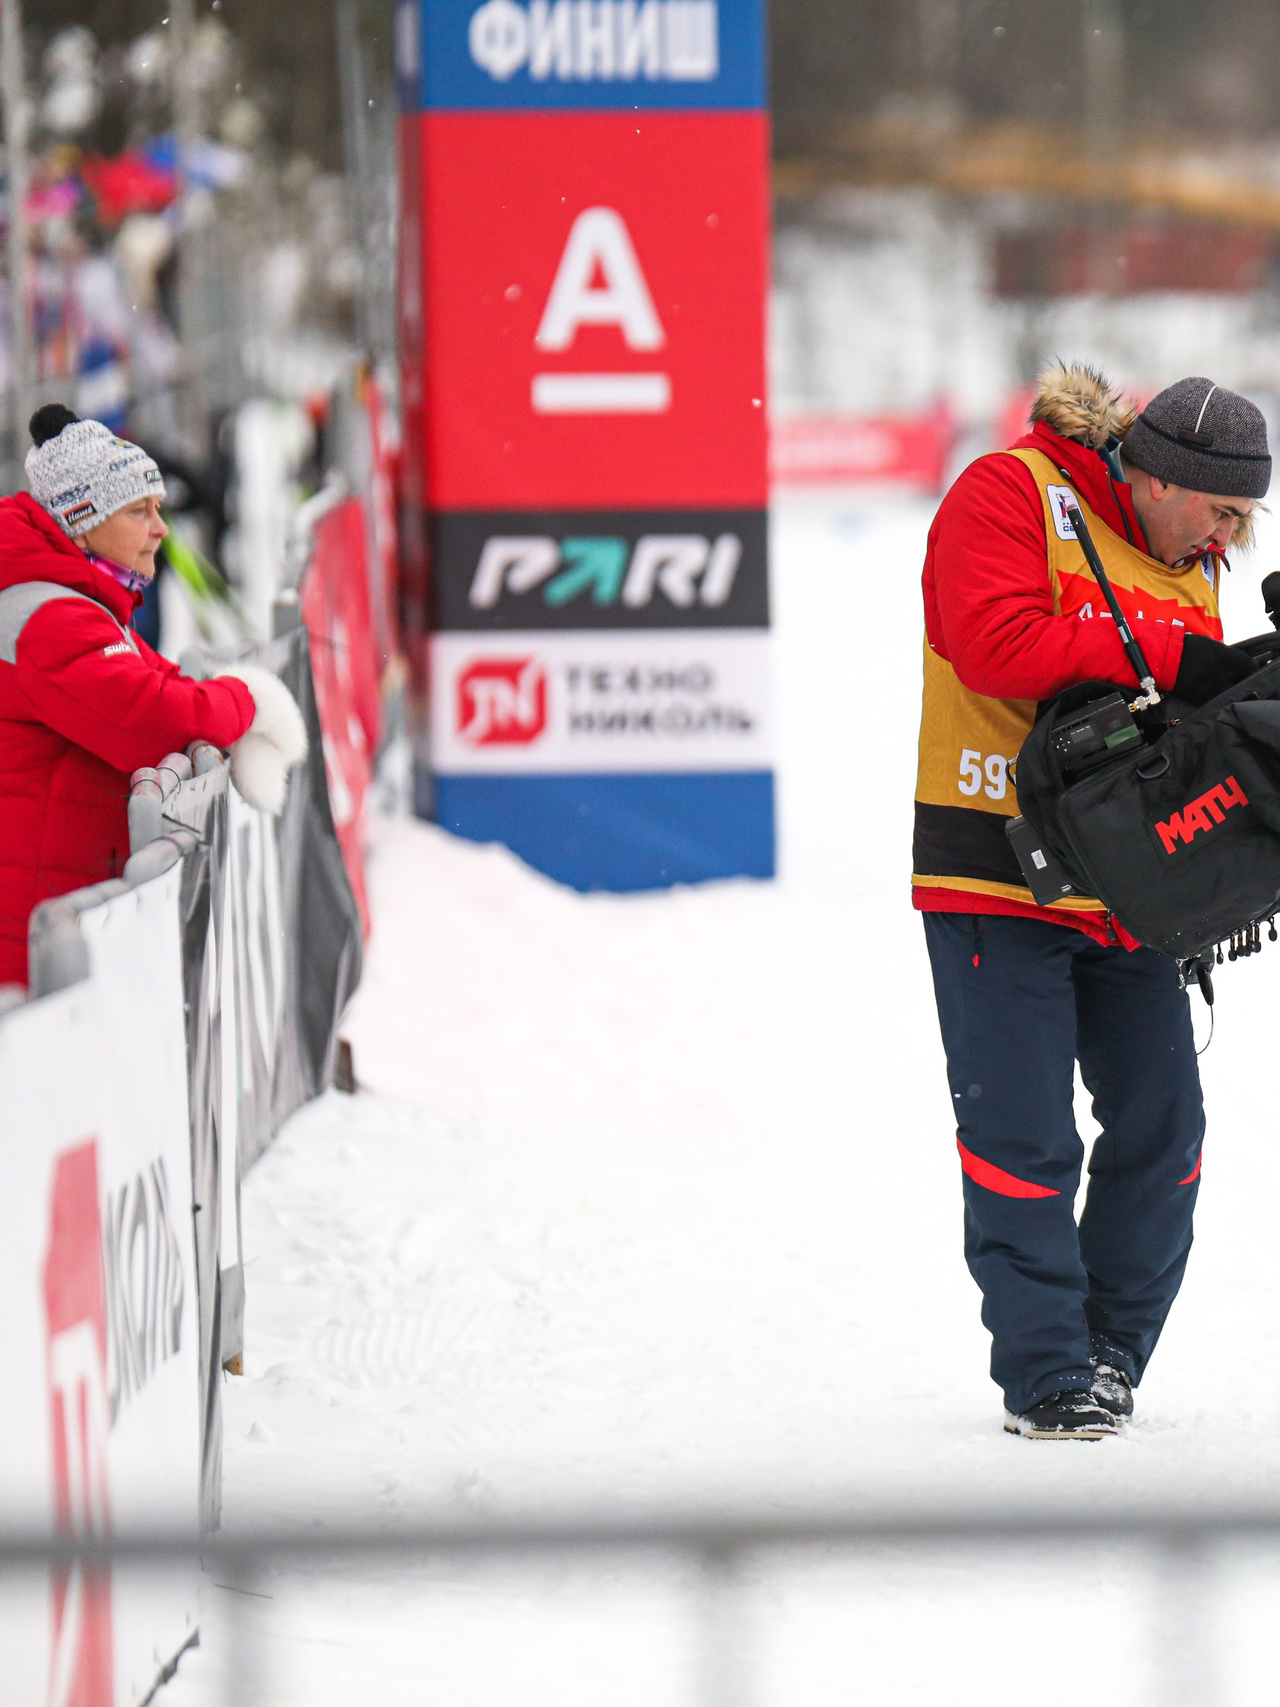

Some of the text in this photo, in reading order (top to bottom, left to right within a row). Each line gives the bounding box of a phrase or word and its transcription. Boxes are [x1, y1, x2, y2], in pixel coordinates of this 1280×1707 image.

[467, 0, 720, 82] ФИНИШ
[468, 533, 742, 607] PARI
[566, 664, 713, 692] ТЕХНО
[568, 707, 756, 738] НИКОЛЬ
[957, 748, 1017, 799] 59
[1154, 775, 1250, 855] МАТЧ
